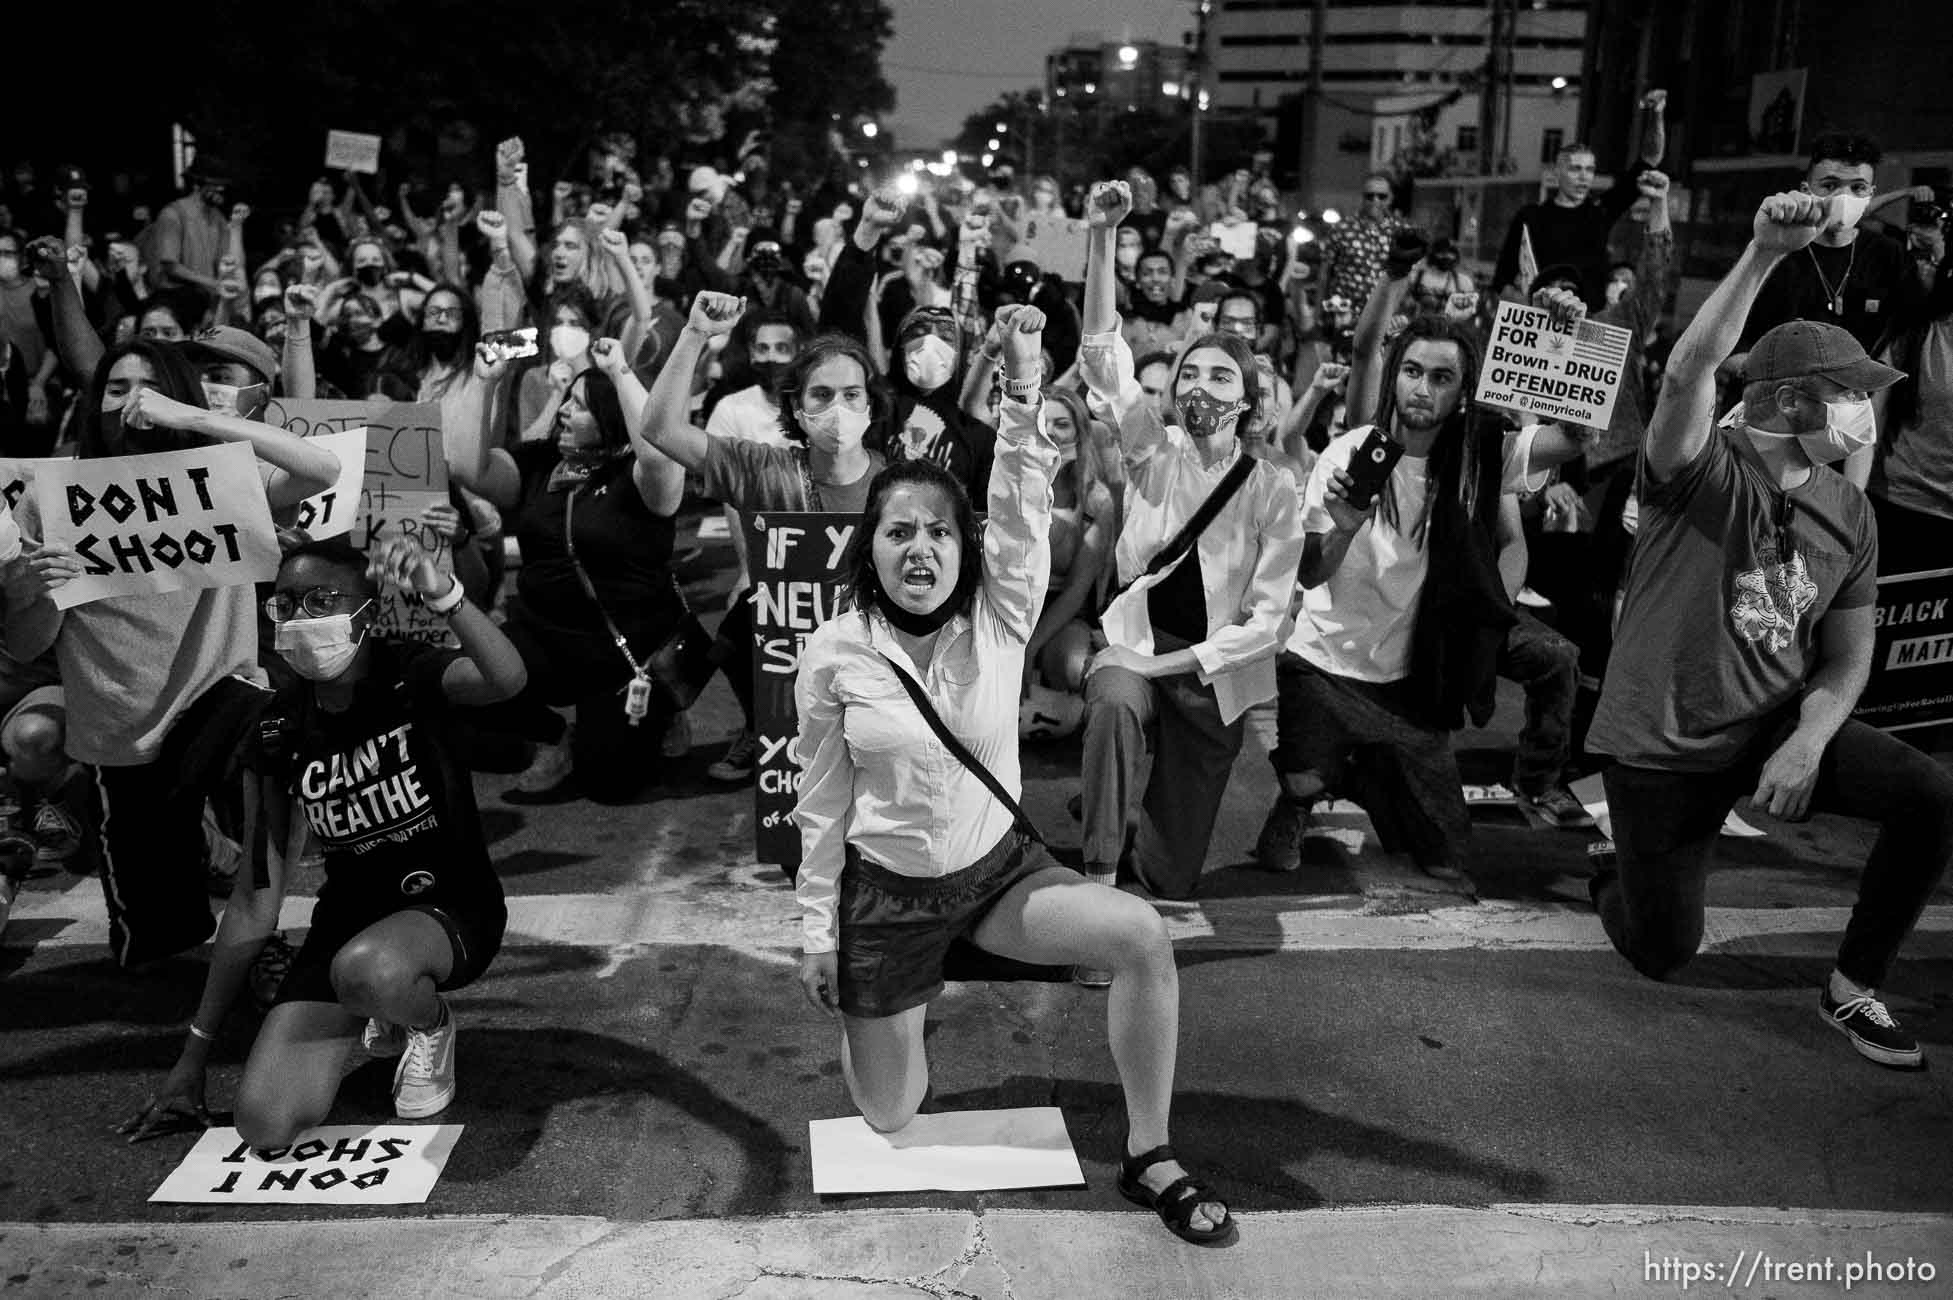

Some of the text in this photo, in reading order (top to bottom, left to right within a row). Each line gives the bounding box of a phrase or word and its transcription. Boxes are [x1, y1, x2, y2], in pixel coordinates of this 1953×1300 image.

[1497, 326, 1538, 348] FOR
[1501, 307, 1575, 336] JUSTICE
[1492, 346, 1549, 370] Brown
[1564, 361, 1617, 385] DRUG
[1483, 390, 1514, 403] proof
[1491, 368, 1606, 406] OFFENDERS
[75, 523, 241, 575] SHOOT
[767, 527, 806, 569] IF
[1875, 598, 1948, 627] BLACK
[1897, 637, 1953, 665] MATT
[302, 722, 412, 800] CAN'T
[298, 765, 430, 838] REATHE
